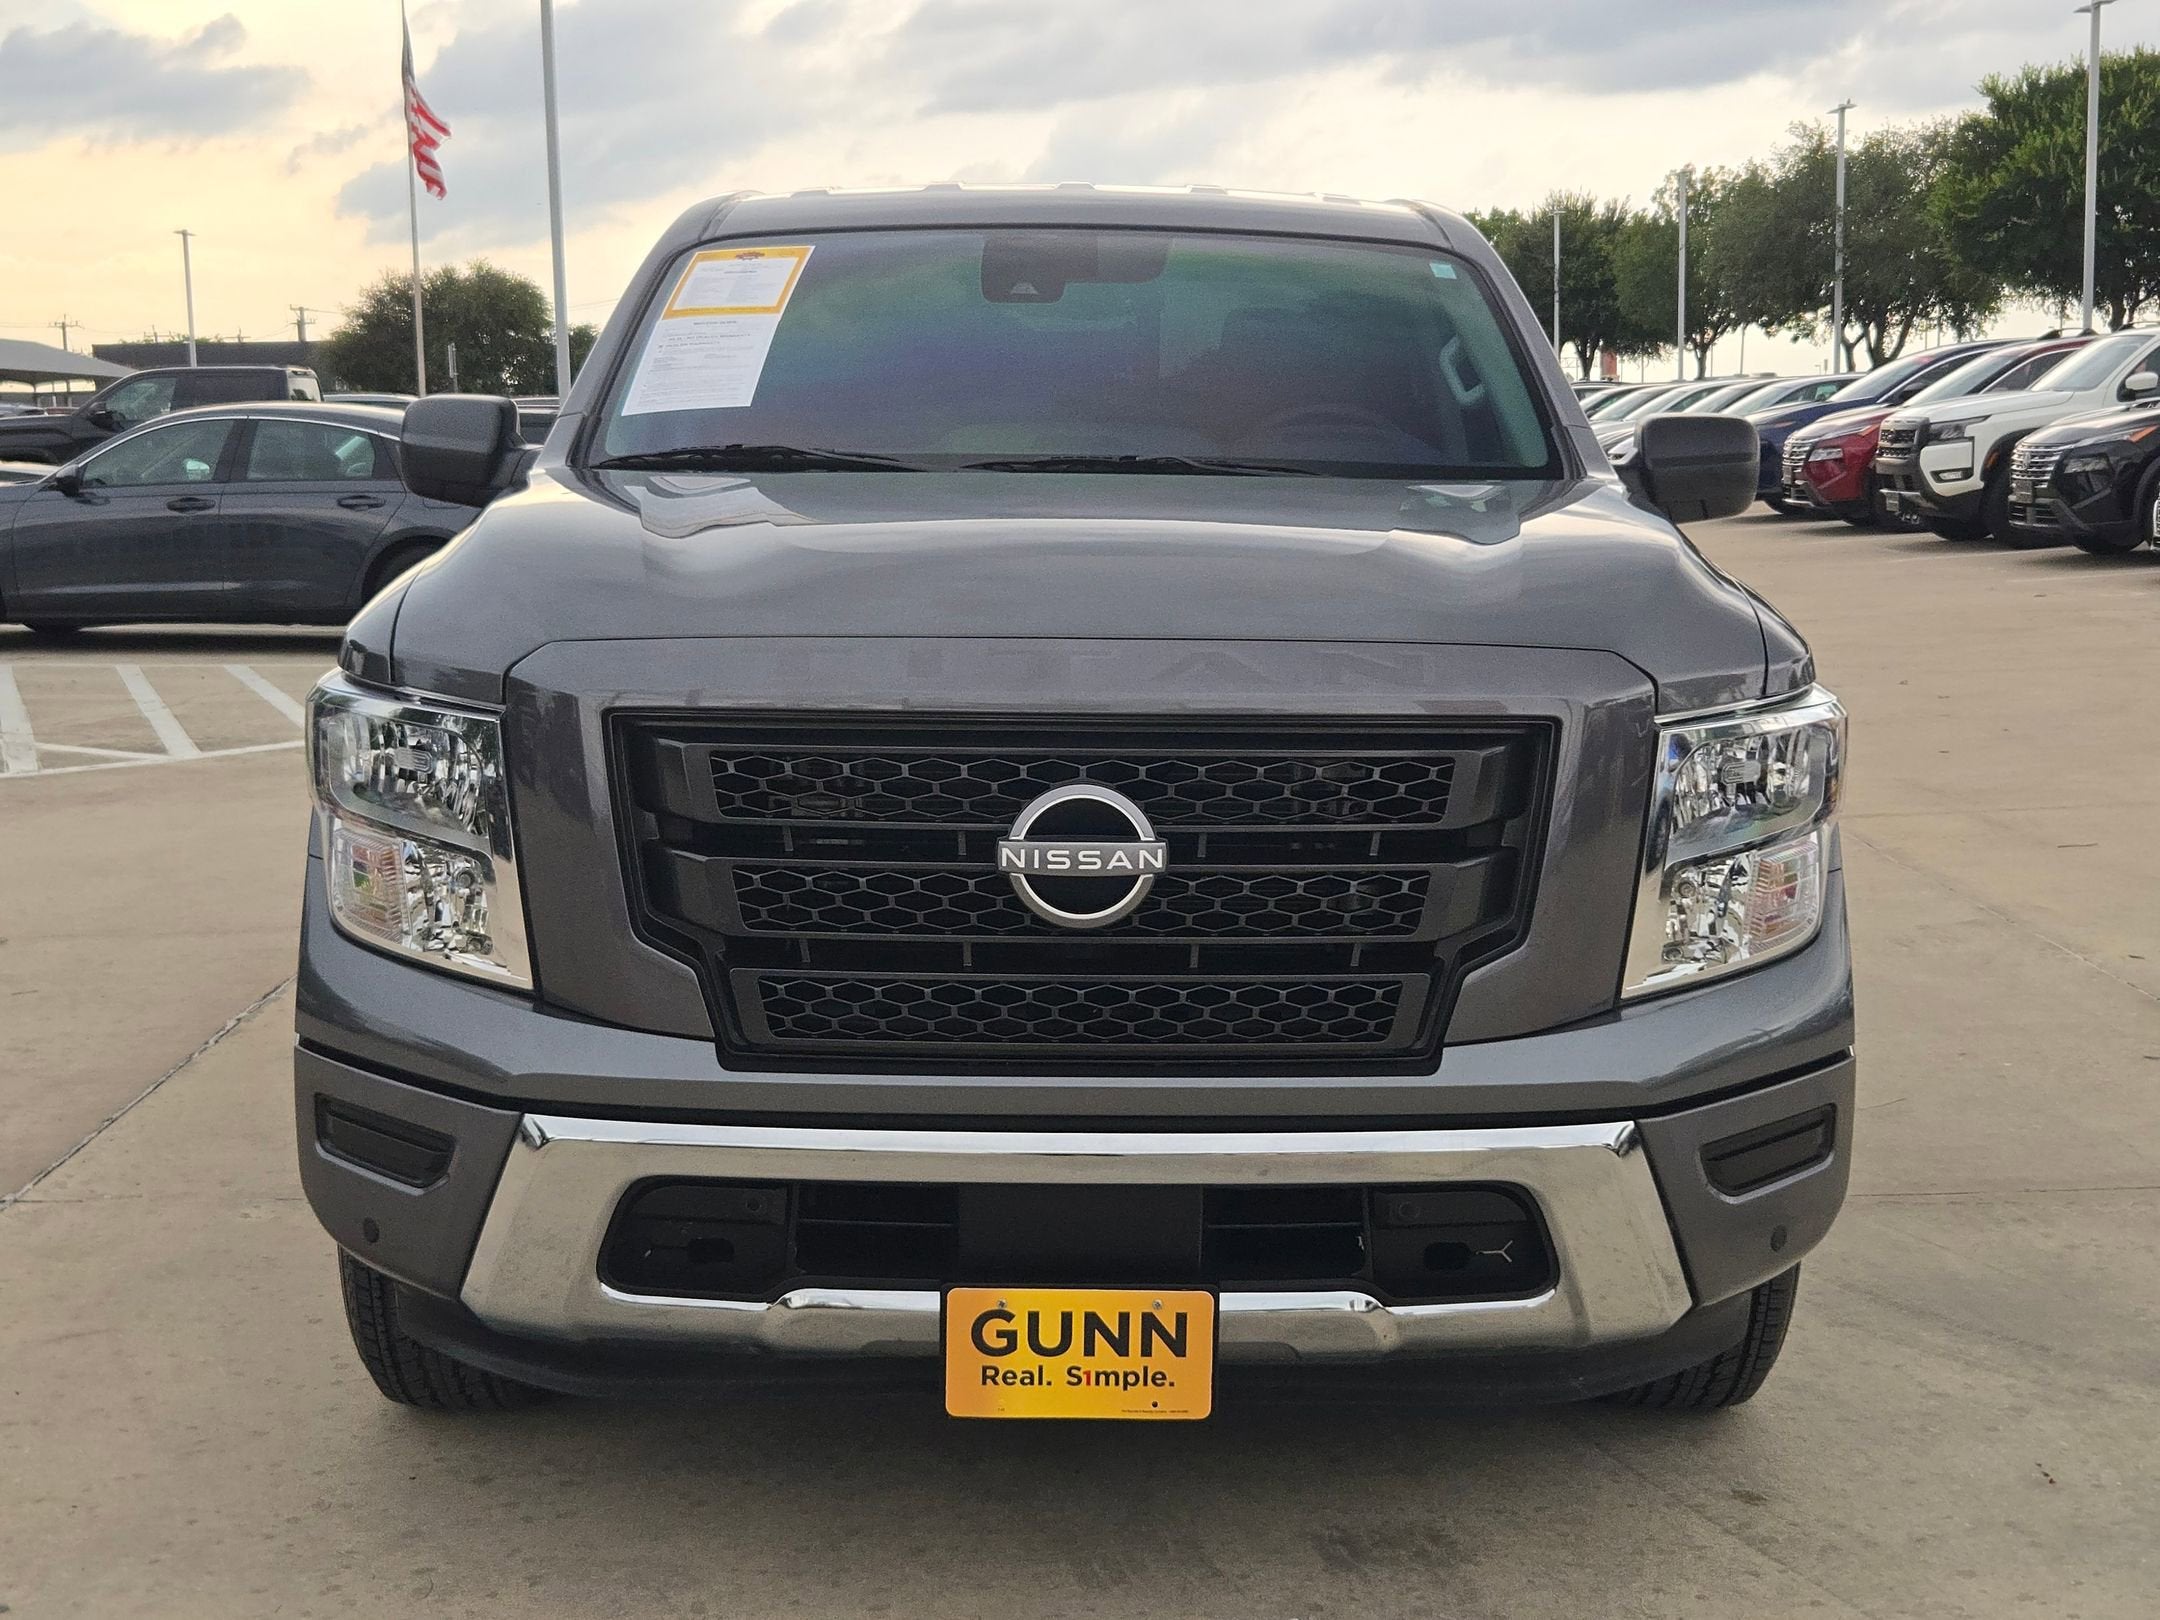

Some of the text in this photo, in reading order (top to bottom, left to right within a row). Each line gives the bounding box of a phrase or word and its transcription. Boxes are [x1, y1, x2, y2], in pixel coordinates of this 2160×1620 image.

[1001, 847, 1163, 870] NISSAN
[970, 1308, 1188, 1358] GUNN
[981, 1365, 1053, 1387] Real.
